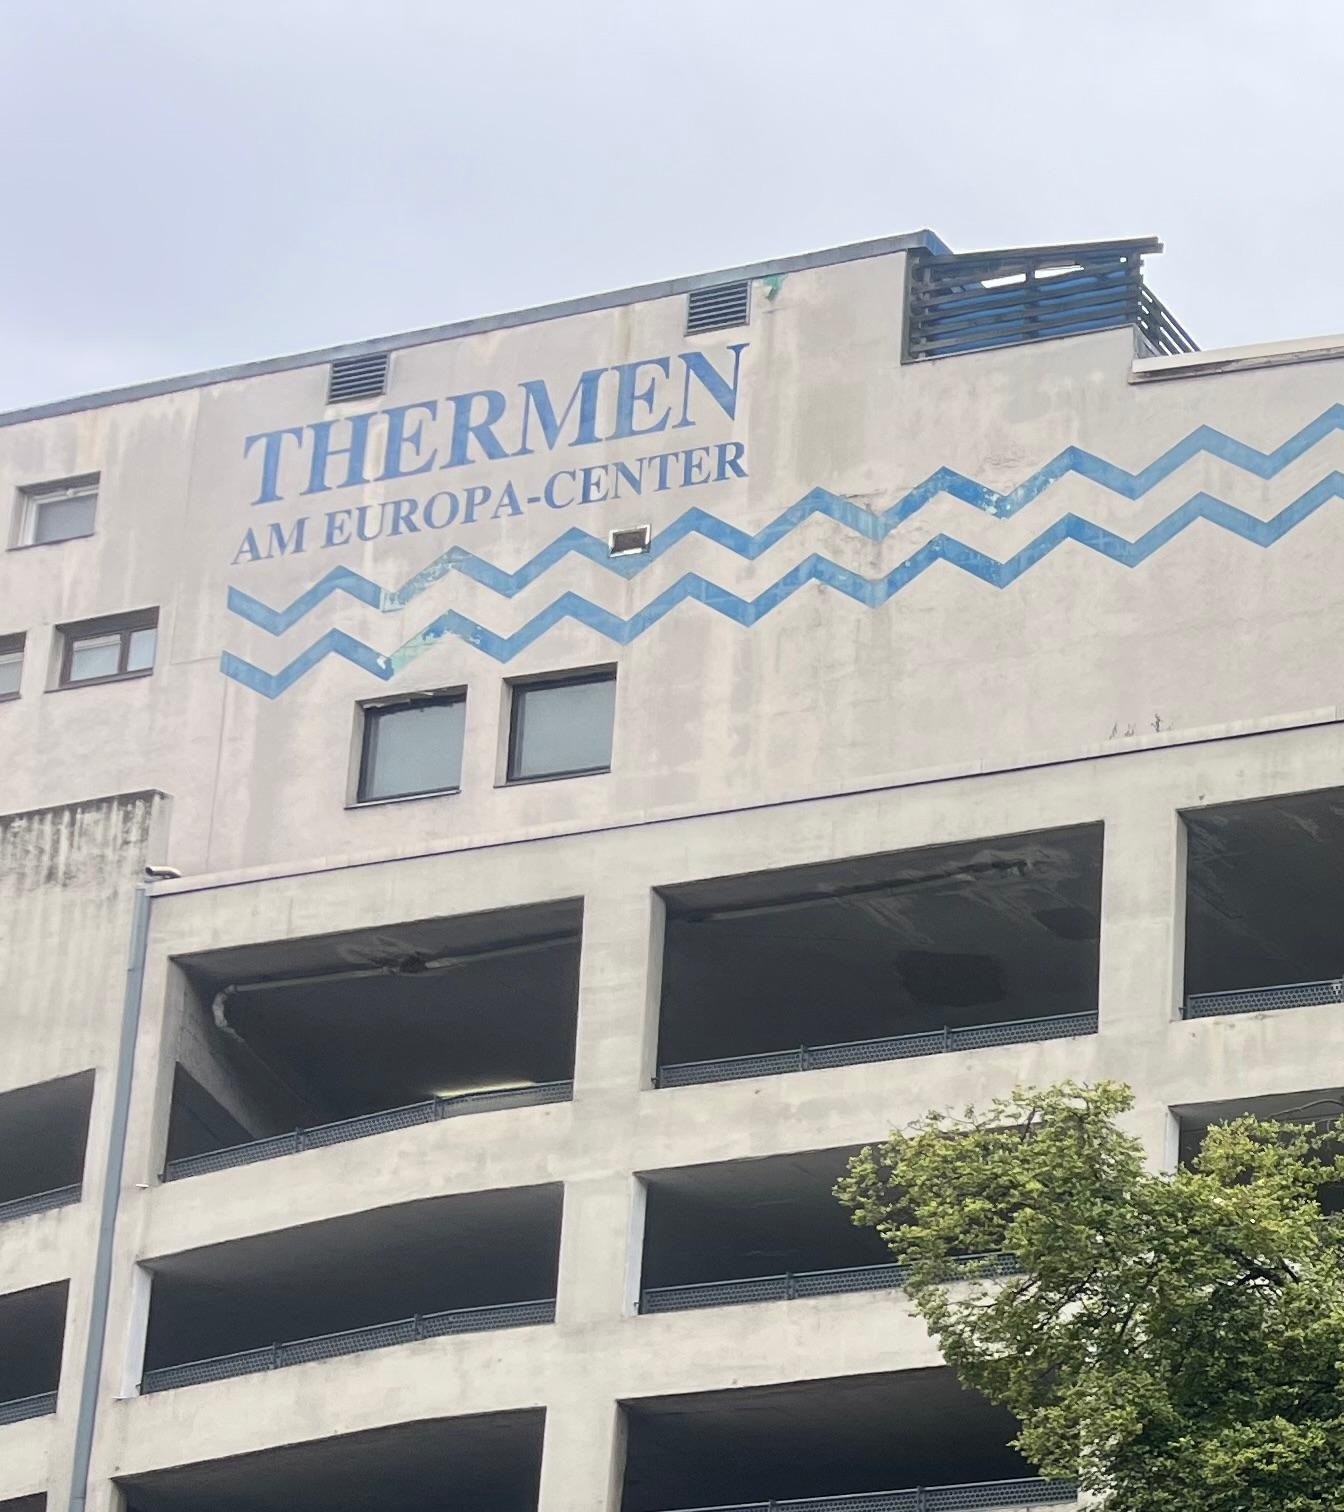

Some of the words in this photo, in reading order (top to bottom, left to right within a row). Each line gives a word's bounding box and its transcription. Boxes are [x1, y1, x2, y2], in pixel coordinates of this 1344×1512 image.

[244, 343, 749, 505] THERMEN
[231, 517, 307, 566] AM
[321, 441, 748, 548] EUROPA-CENTER
